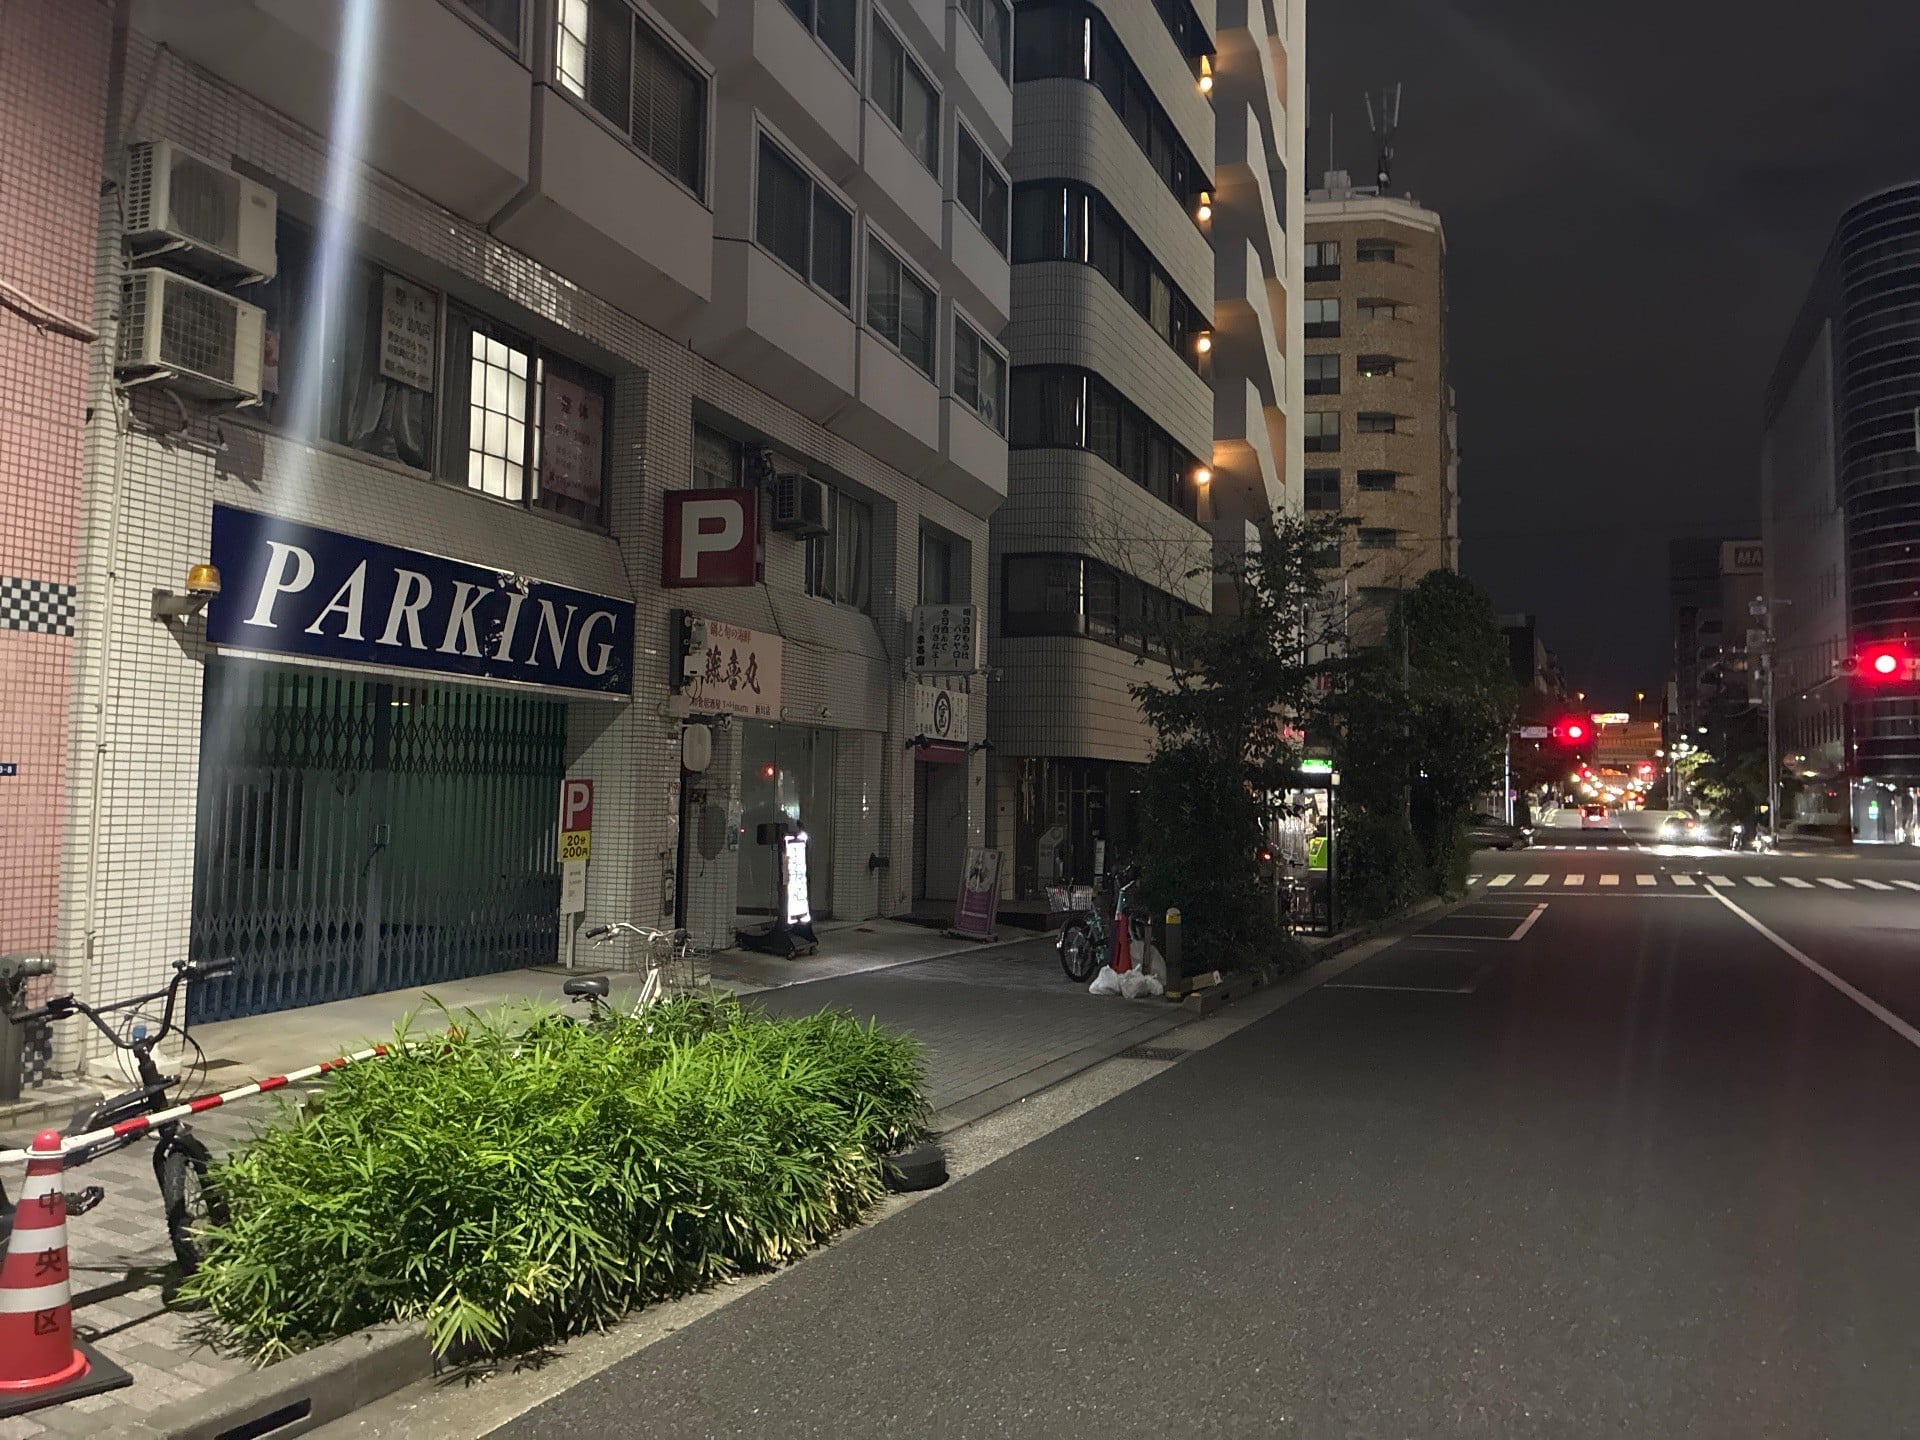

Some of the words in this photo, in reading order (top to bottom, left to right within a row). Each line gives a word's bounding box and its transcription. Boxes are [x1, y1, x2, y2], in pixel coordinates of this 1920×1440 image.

[680, 499, 744, 578] P
[243, 540, 618, 677] PARKING
[565, 782, 590, 829] P
[562, 846, 588, 859] 200円
[567, 835, 586, 846] 20分
[34, 1187, 64, 1337] 中央区
